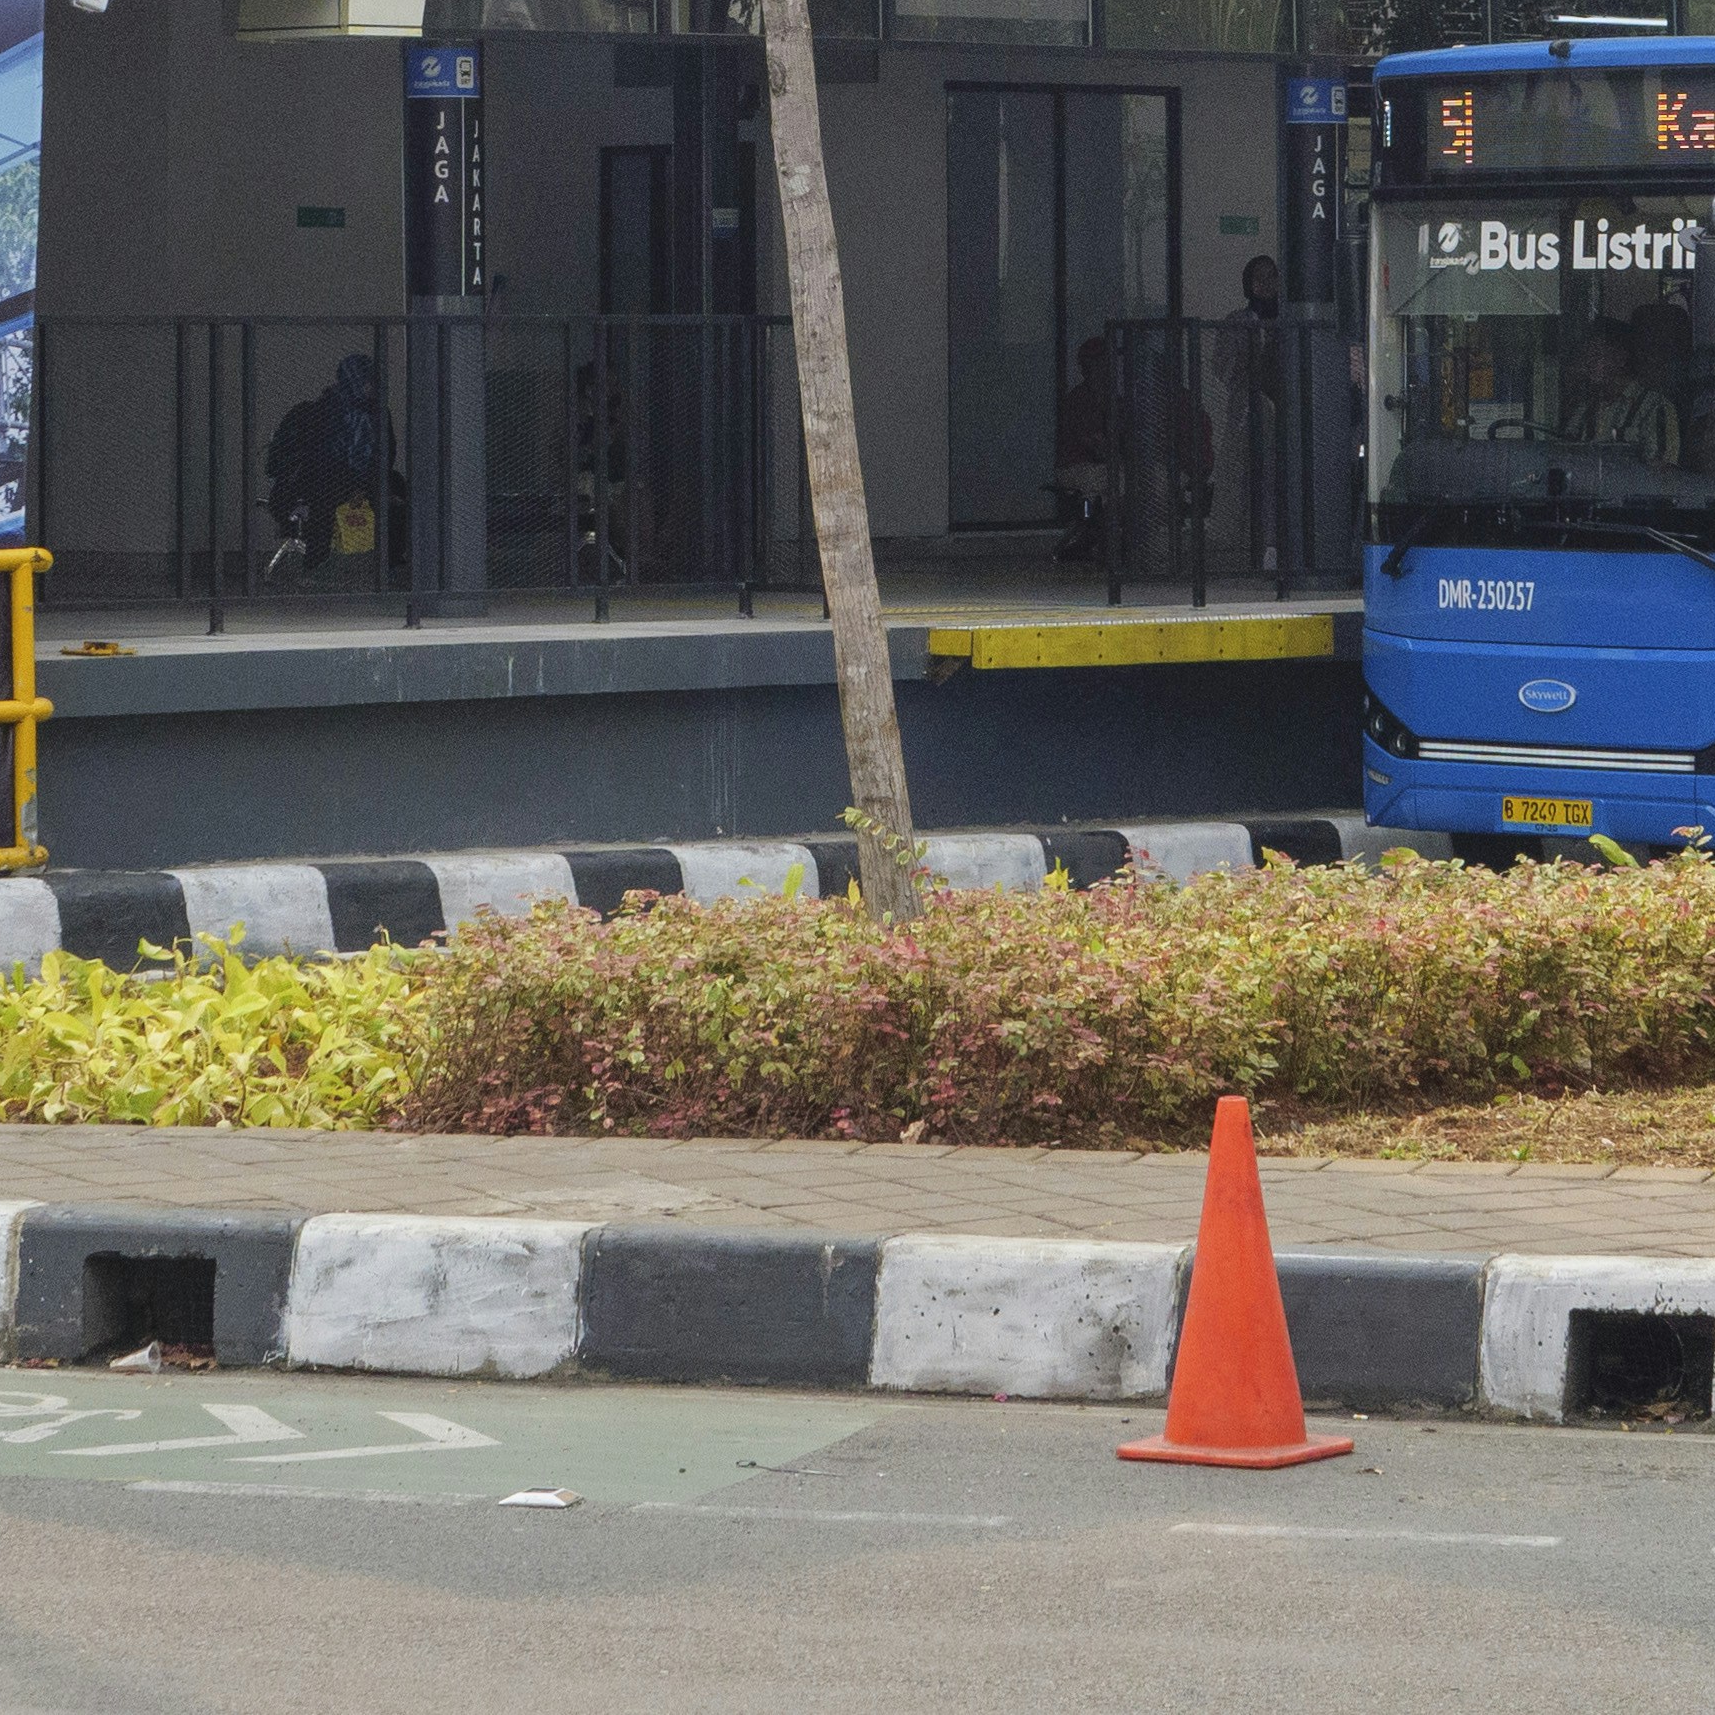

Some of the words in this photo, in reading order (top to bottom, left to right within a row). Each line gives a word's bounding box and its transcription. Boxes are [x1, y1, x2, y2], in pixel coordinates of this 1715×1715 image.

[435, 111, 450, 203] JAGA
[1311, 135, 1326, 219] JAGA
[472, 119, 482, 286] JAKARTA
[1480, 220, 1561, 271] Bus
[1438, 579, 1535, 611] DMR-250257
[1504, 799, 1514, 819] B
